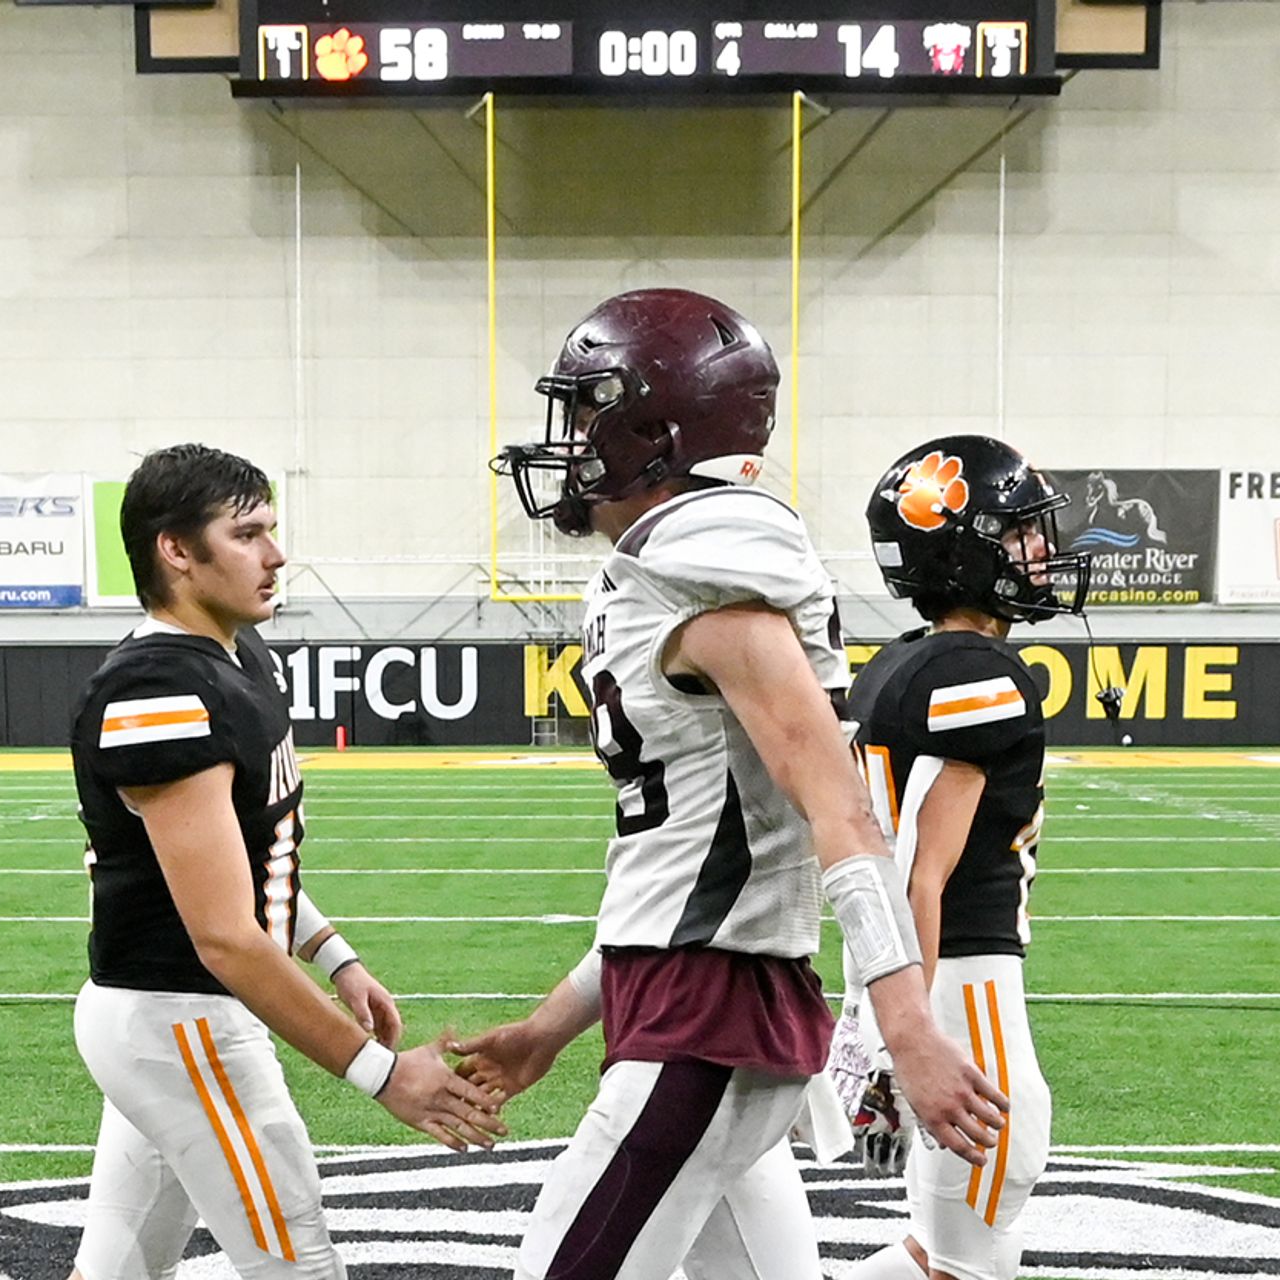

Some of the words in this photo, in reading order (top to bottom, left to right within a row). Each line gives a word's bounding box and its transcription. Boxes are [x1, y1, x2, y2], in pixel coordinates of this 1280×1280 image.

[380, 28, 448, 80] 58
[599, 31, 697, 77] 0:00
[716, 40, 741, 76] 4
[838, 25, 900, 78] 14
[1110, 569, 1126, 588] &
[1128, 572, 1183, 585] LODGE
[1144, 546, 1200, 573] River
[1017, 644, 1239, 720] OME
